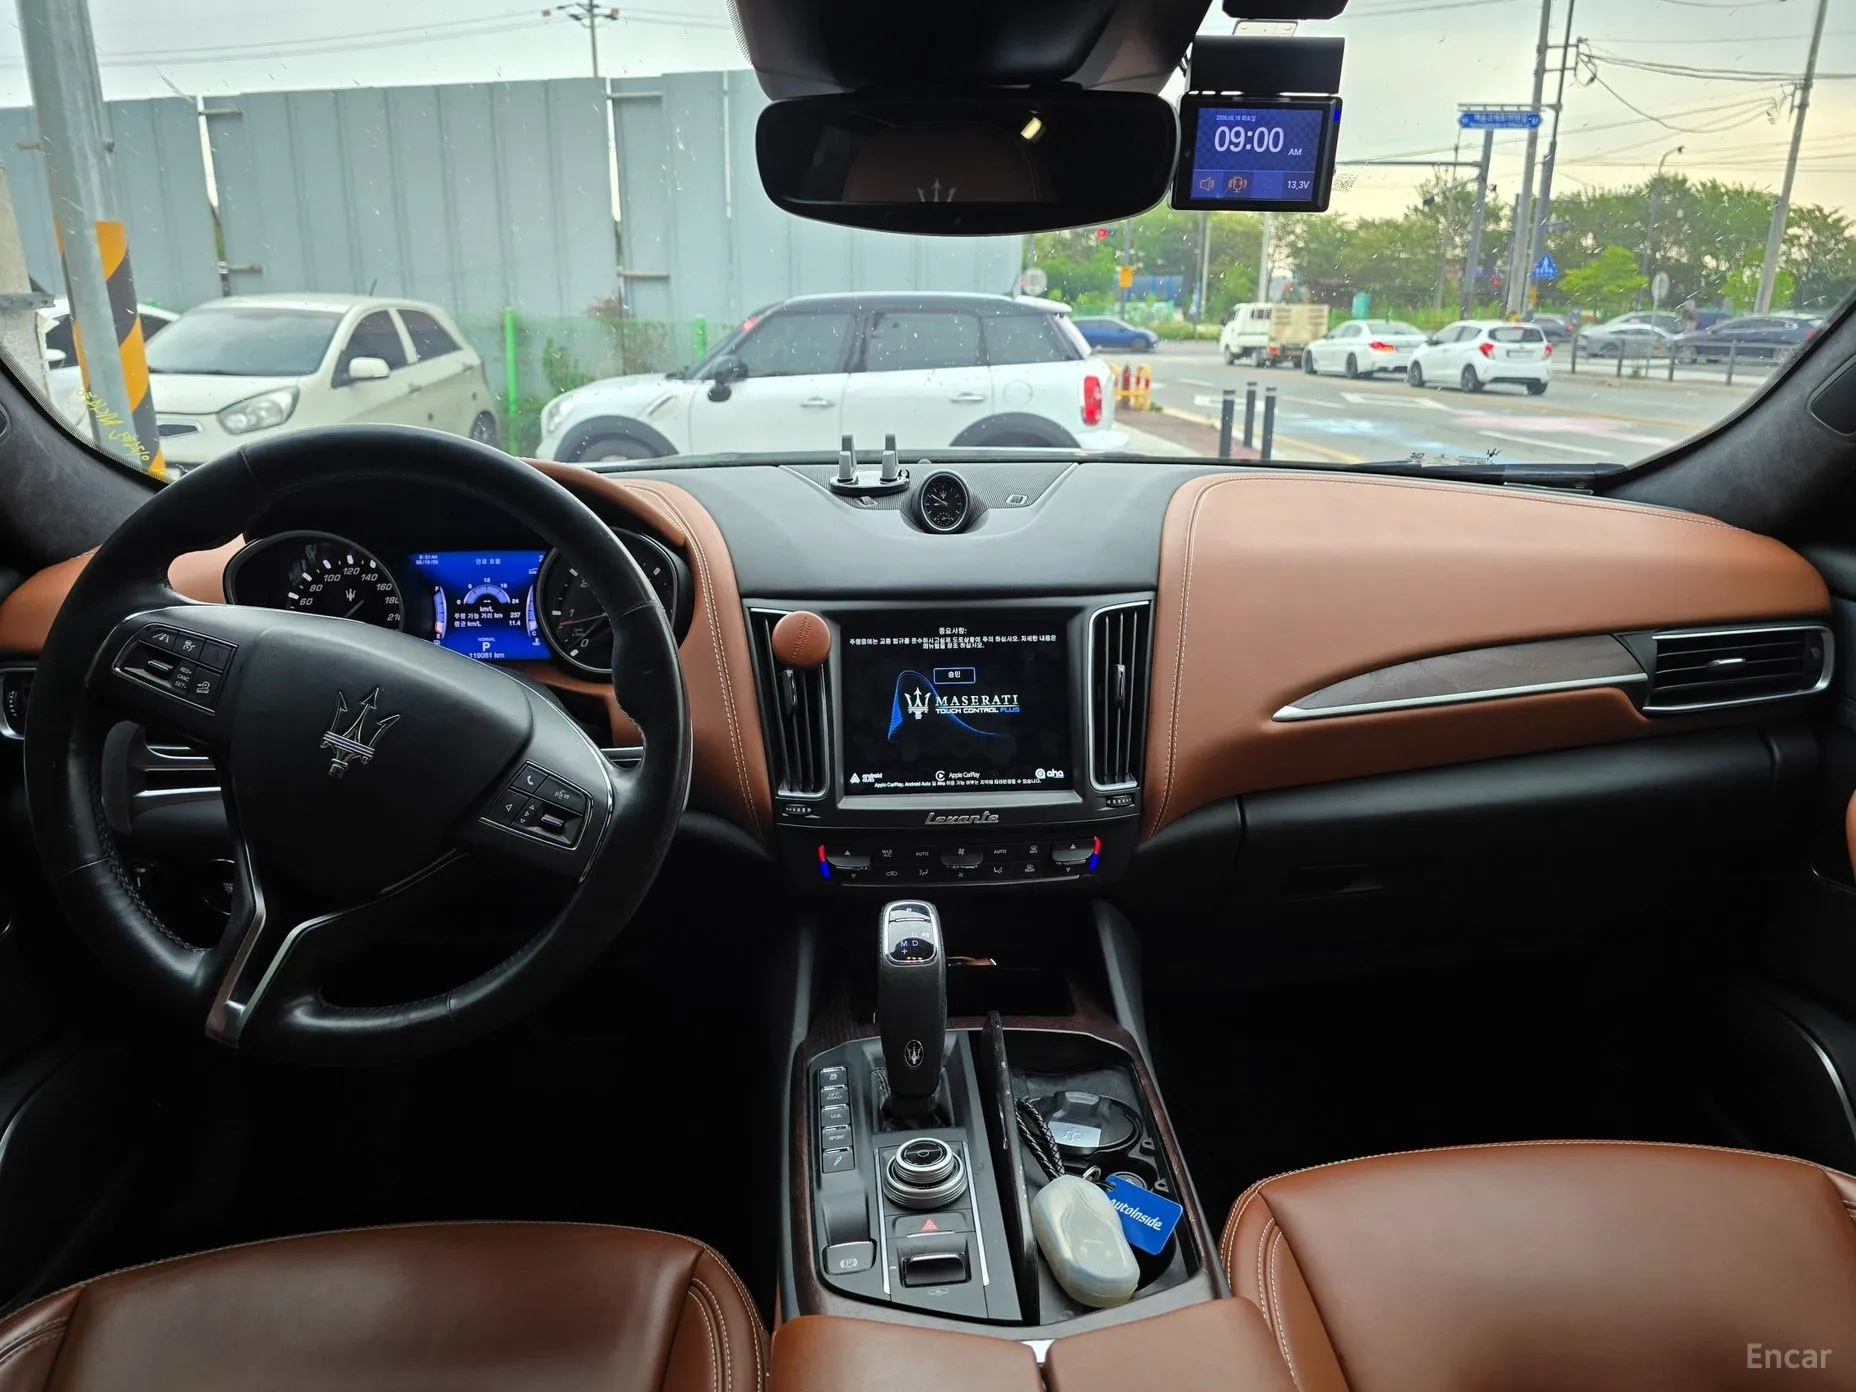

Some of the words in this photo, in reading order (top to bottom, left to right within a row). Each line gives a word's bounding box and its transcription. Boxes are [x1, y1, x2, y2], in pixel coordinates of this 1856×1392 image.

[1214, 126, 1284, 153] 09:00
[343, 567, 360, 575] 120
[324, 574, 341, 582] 100
[361, 573, 378, 581] 140
[309, 584, 323, 592] 80
[376, 583, 392, 591] 160
[299, 598, 313, 606] 60
[569, 608, 575, 617] 1
[482, 641, 491, 652] P
[580, 638, 589, 647] 0
[493, 651, 505, 659] km
[948, 670, 961, 678] 승인
[935, 694, 1019, 706] MASERATI
[963, 706, 999, 714] CONTROL
[1046, 769, 1064, 778] aha
[925, 810, 999, 825] Levante
